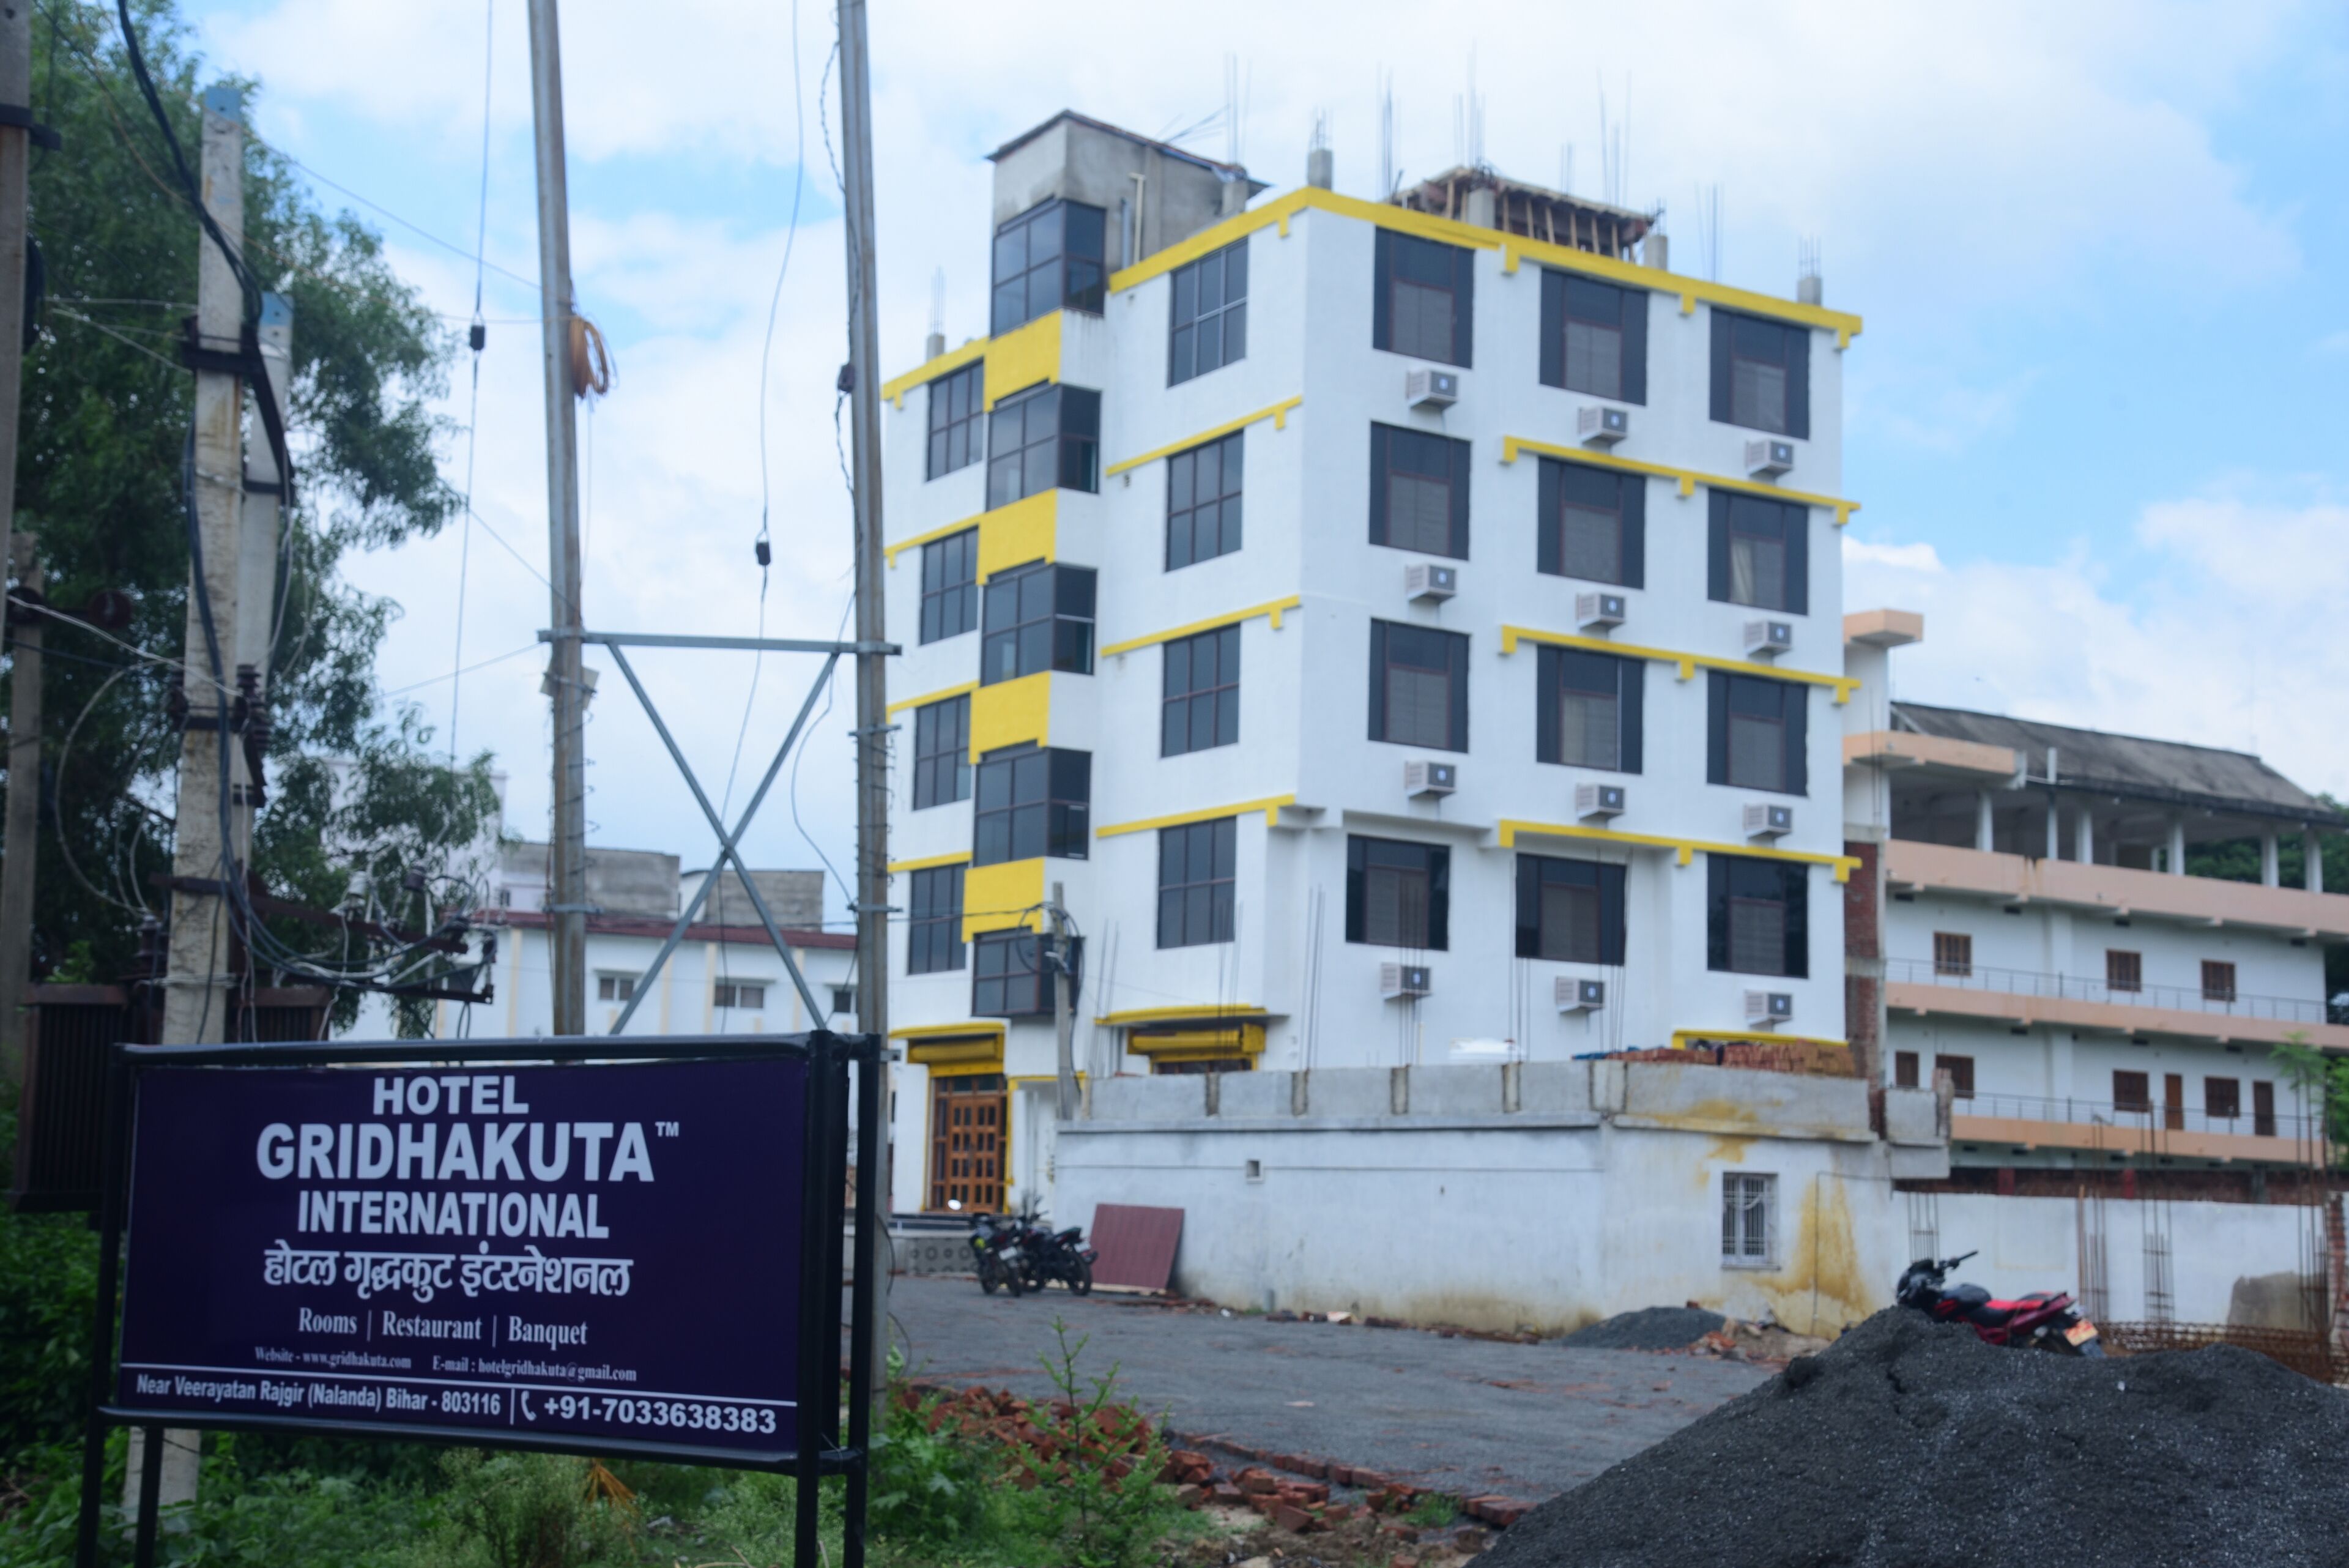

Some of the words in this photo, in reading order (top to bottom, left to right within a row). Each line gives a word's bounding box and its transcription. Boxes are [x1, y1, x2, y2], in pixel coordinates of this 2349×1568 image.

[373, 1076, 530, 1115] HOTEL
[256, 1122, 655, 1182] GRIDHAKUTA
[298, 1190, 609, 1239] INTERNATIONAL
[264, 1239, 340, 1286] होटल
[459, 1240, 634, 1298] इंटरनेशनल
[299, 1307, 357, 1335] Rooms
[382, 1310, 481, 1341] Restaurant
[508, 1316, 588, 1351] Banquet
[255, 1346, 294, 1363] Website
[433, 1355, 469, 1373] E-mail
[136, 1374, 172, 1395] Near
[174, 1375, 256, 1403] Veerayatan
[260, 1380, 305, 1407] Rajgir
[308, 1383, 382, 1414] (Nalanda)
[386, 1387, 429, 1411] Bihar
[441, 1390, 501, 1416] 803116
[544, 1395, 777, 1434] +91-7033638383
